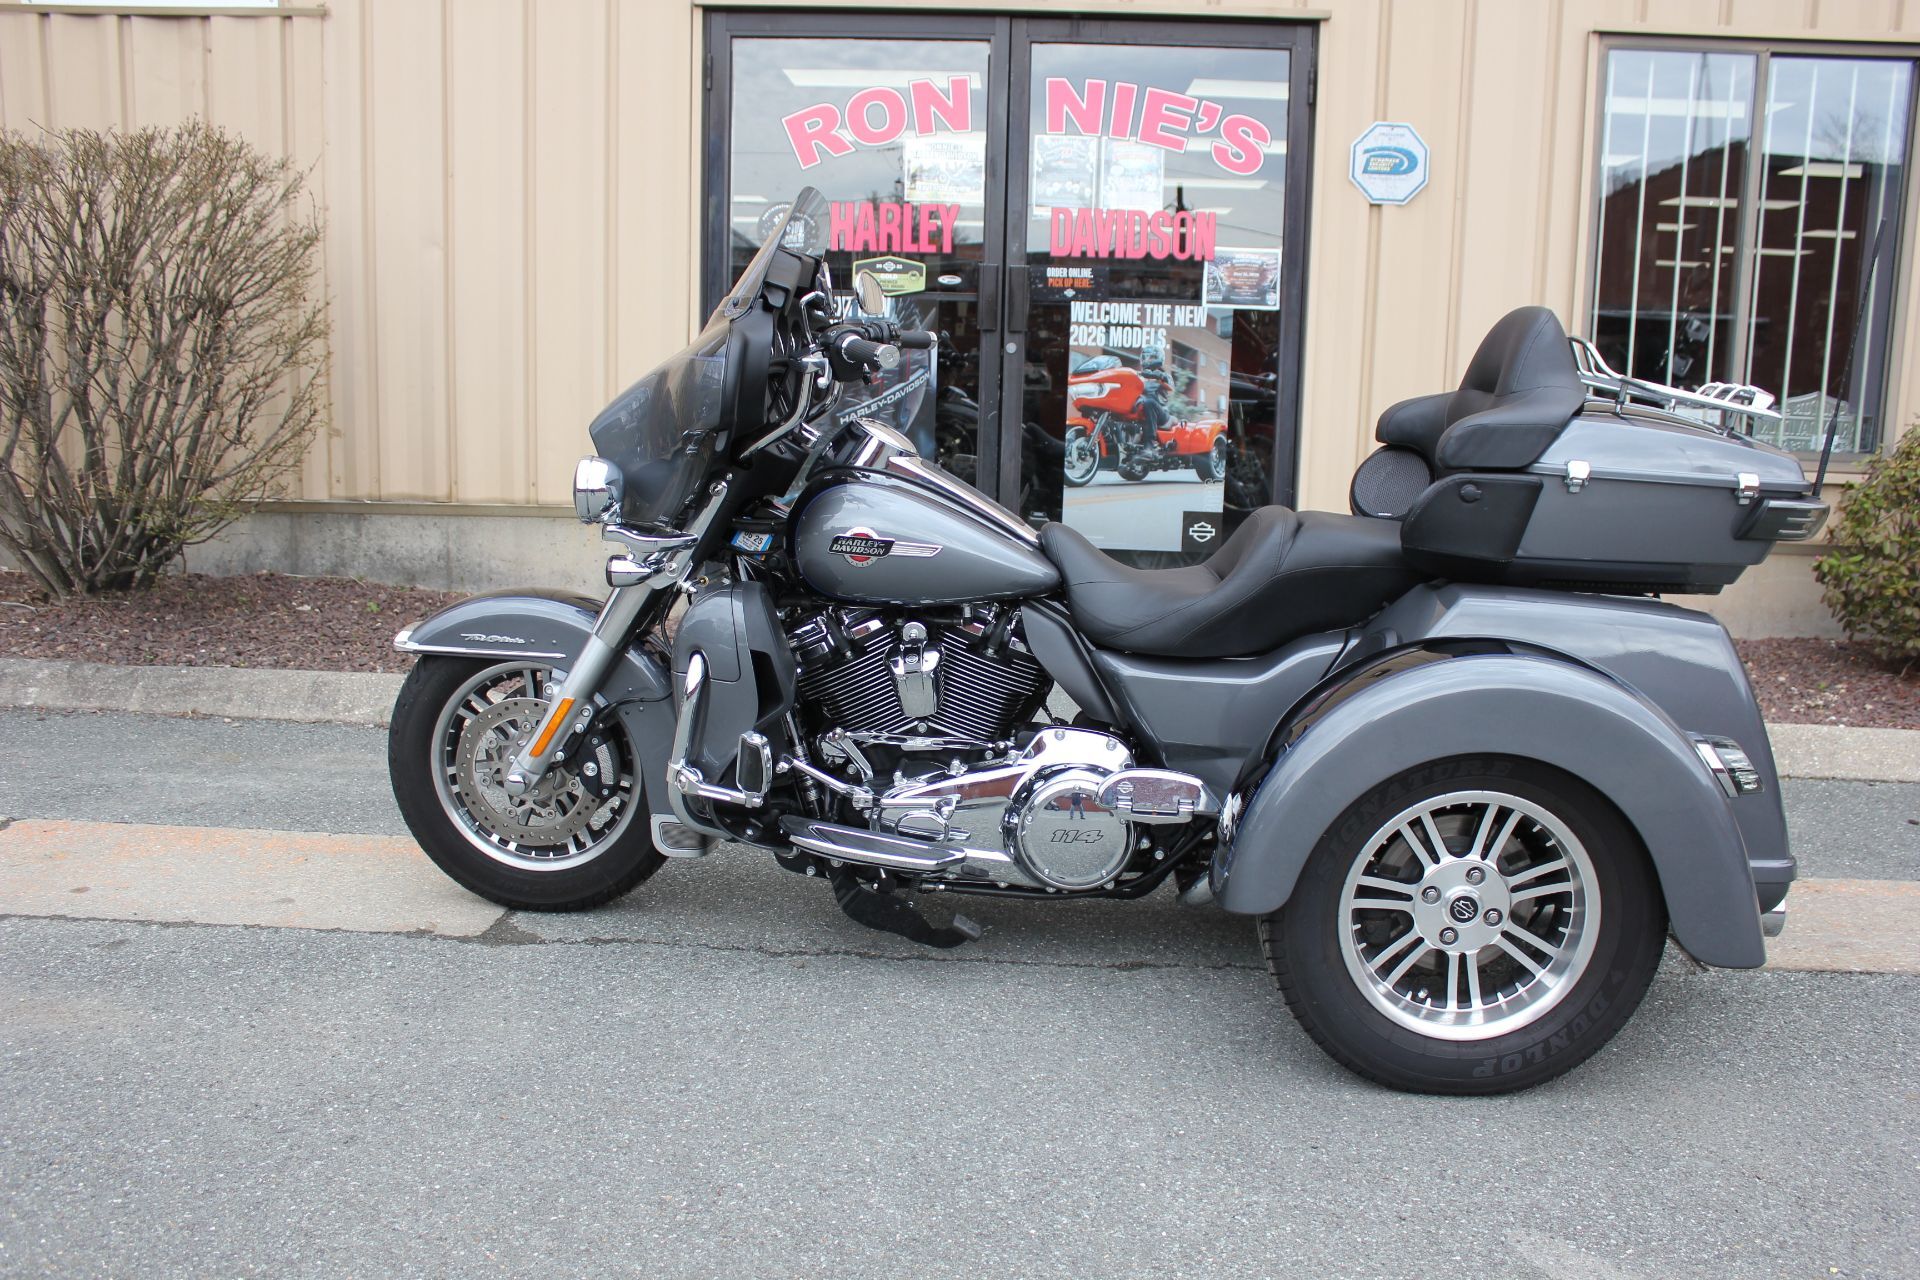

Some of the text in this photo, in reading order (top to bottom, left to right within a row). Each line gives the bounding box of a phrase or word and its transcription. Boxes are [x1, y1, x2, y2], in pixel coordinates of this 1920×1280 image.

[782, 75, 1272, 176] RON NIE'S
[830, 201, 961, 254] HARLEY
[1050, 207, 1217, 262] DAVIDSON
[1046, 267, 1068, 278] ORDER
[1048, 278, 1064, 287] PICK
[1064, 278, 1073, 287] UP
[1070, 301, 1208, 328] WELCOME THE NEW
[1069, 324, 1106, 347] 2026
[840, 371, 930, 425] HARLEY-DAVIDSON
[832, 544, 885, 555] DAVIDSON
[1050, 829, 1104, 844] 114
[1472, 990, 1611, 1078] DUNLOP
